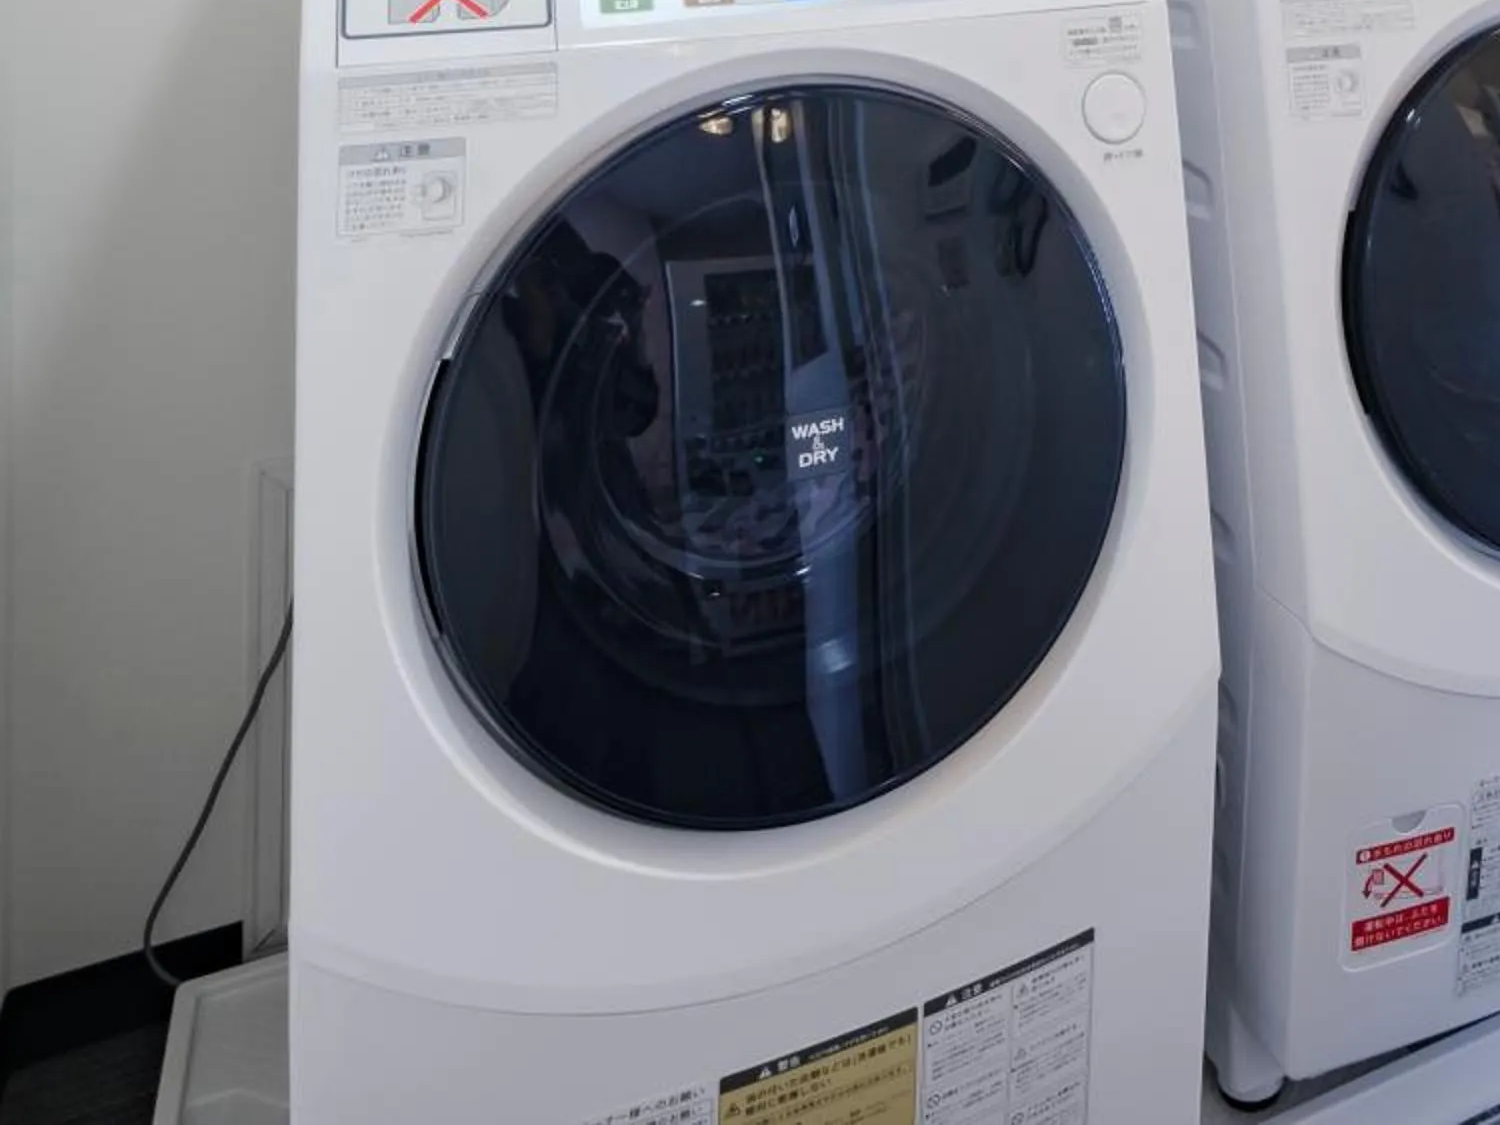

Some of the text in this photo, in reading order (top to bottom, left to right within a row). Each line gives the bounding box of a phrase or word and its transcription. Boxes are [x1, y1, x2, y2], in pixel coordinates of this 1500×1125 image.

[791, 416, 845, 440] WASH
[812, 435, 825, 450] &
[798, 446, 839, 468] DRY
